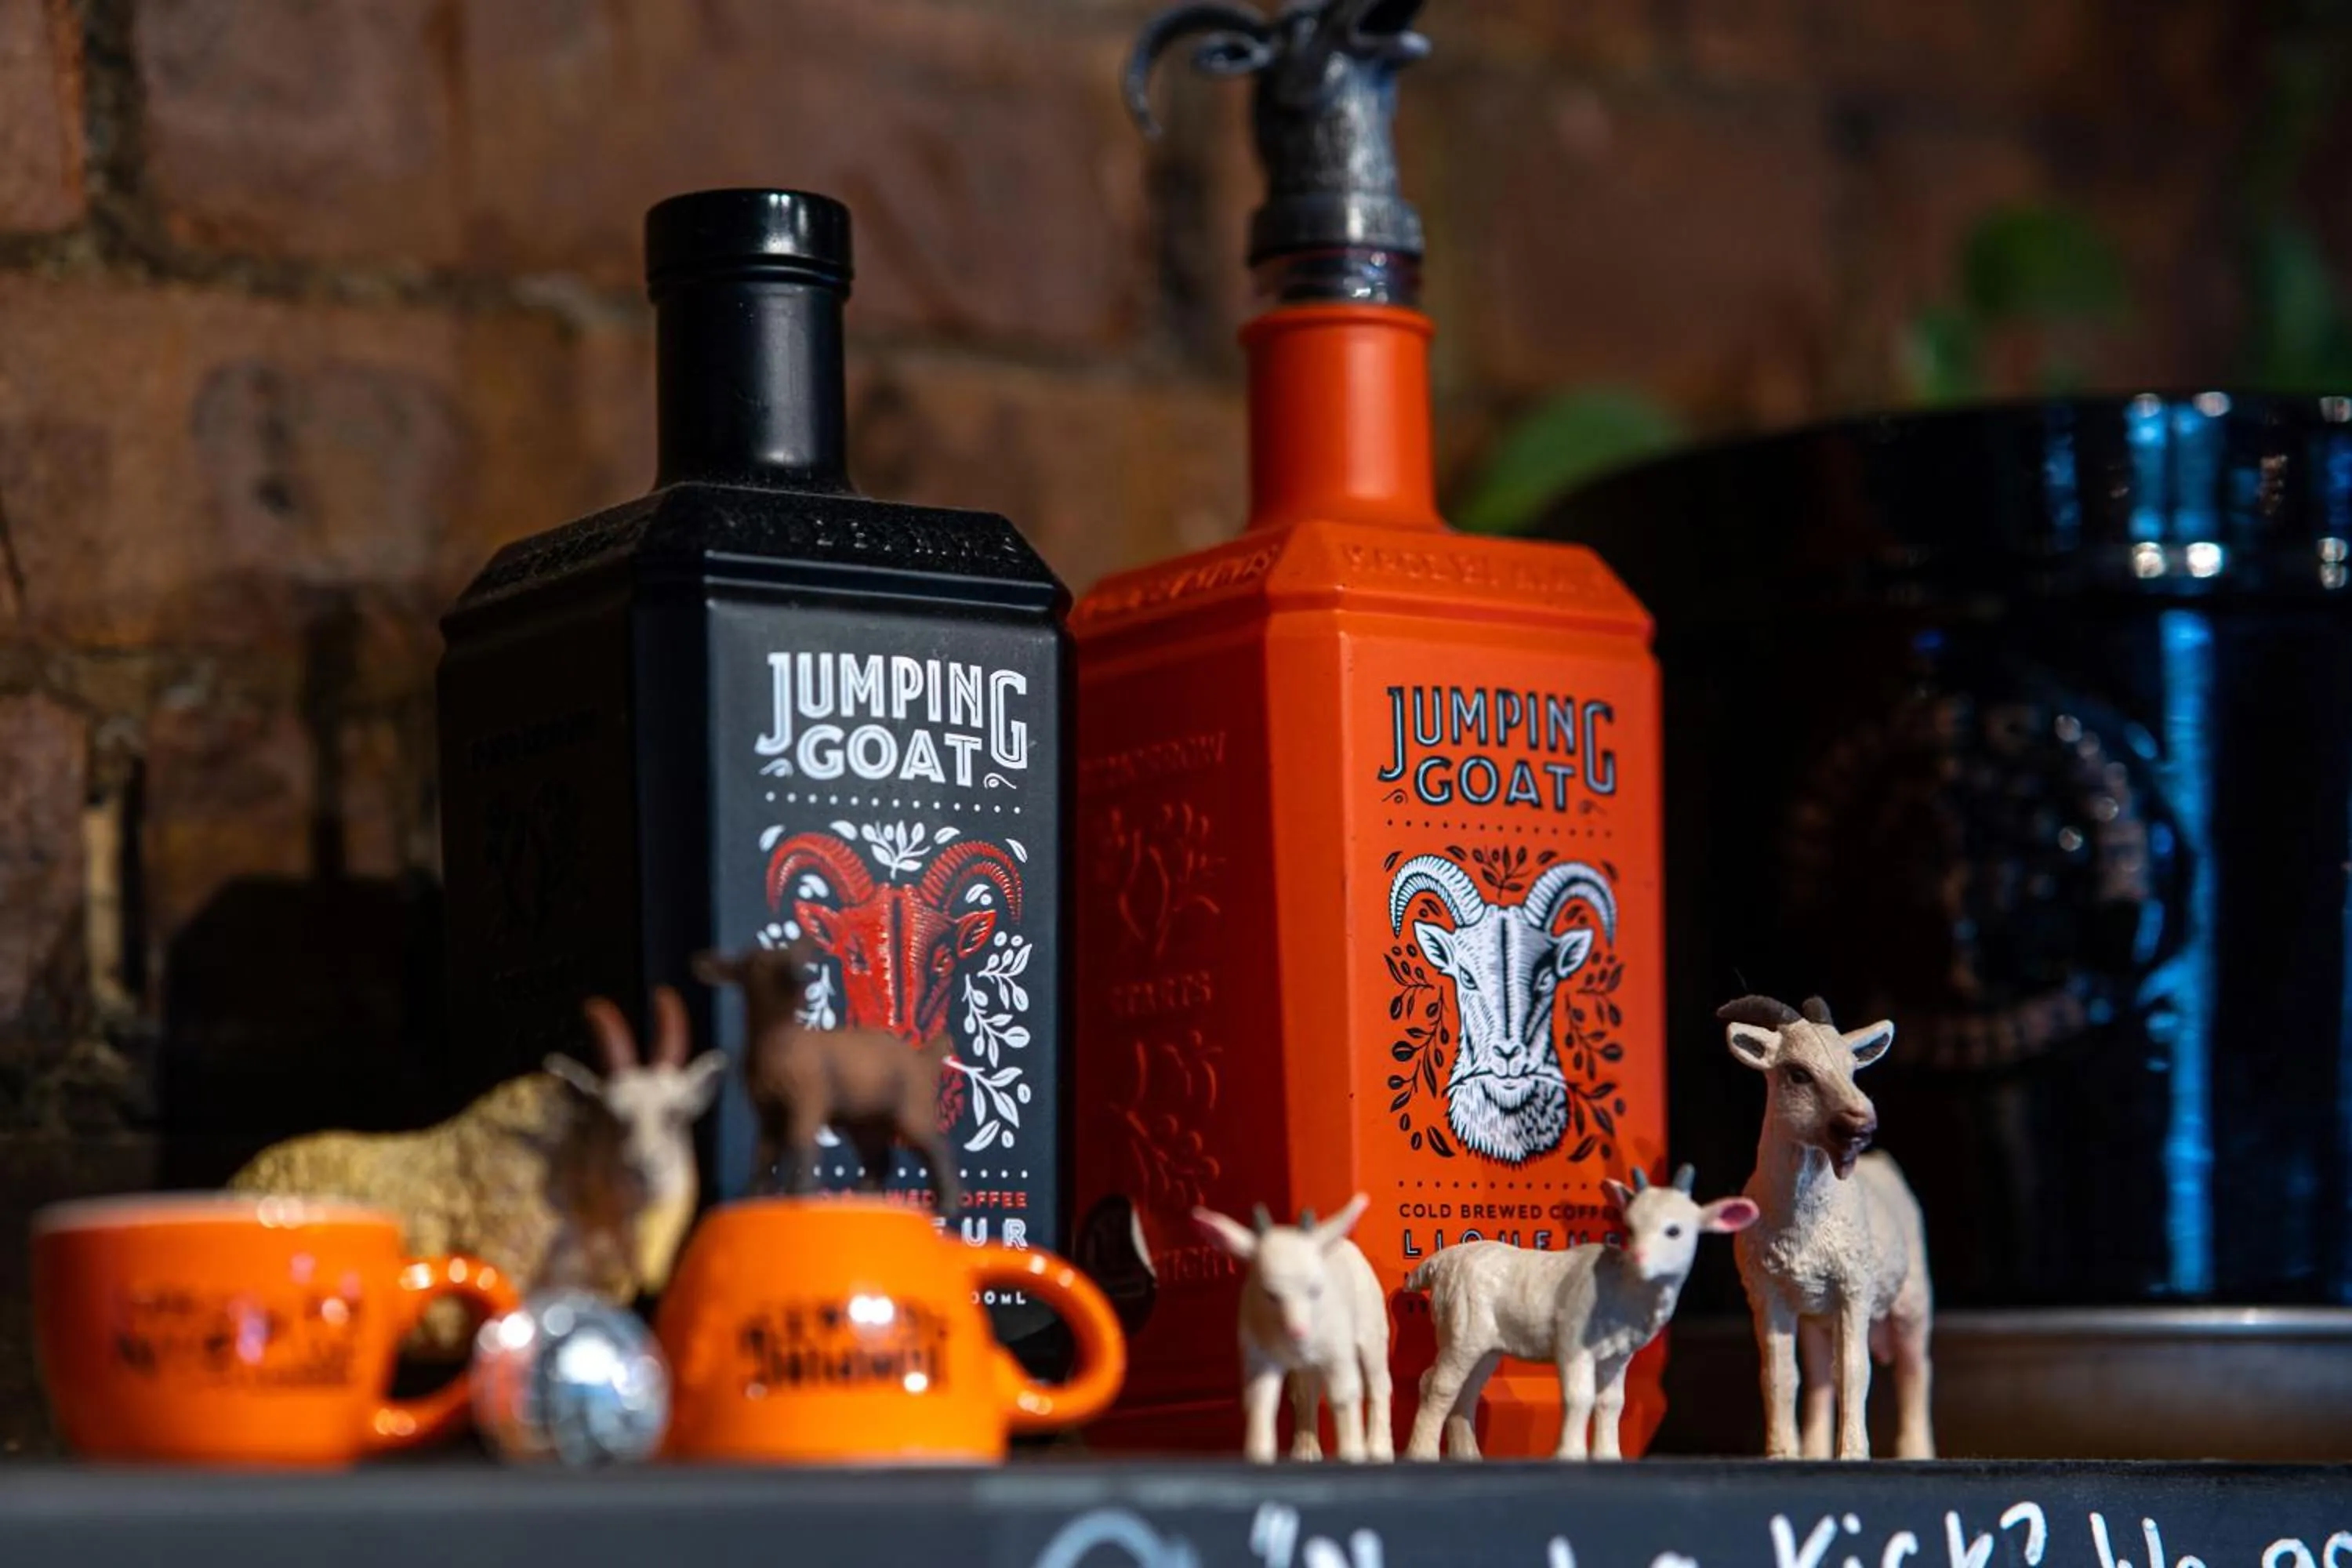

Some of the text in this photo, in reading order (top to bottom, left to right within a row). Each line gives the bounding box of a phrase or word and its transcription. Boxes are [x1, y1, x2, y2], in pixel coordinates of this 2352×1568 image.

[754, 652, 1028, 769] JUMPING
[797, 724, 983, 787] GOAT
[1377, 685, 1617, 796] JUMPING
[1414, 755, 1576, 813] GOAT
[958, 1190, 1028, 1208] OFFEE
[1399, 1203, 1452, 1219] COLD
[1460, 1203, 1543, 1220] BREWED
[970, 1290, 1027, 1305] 00ML
